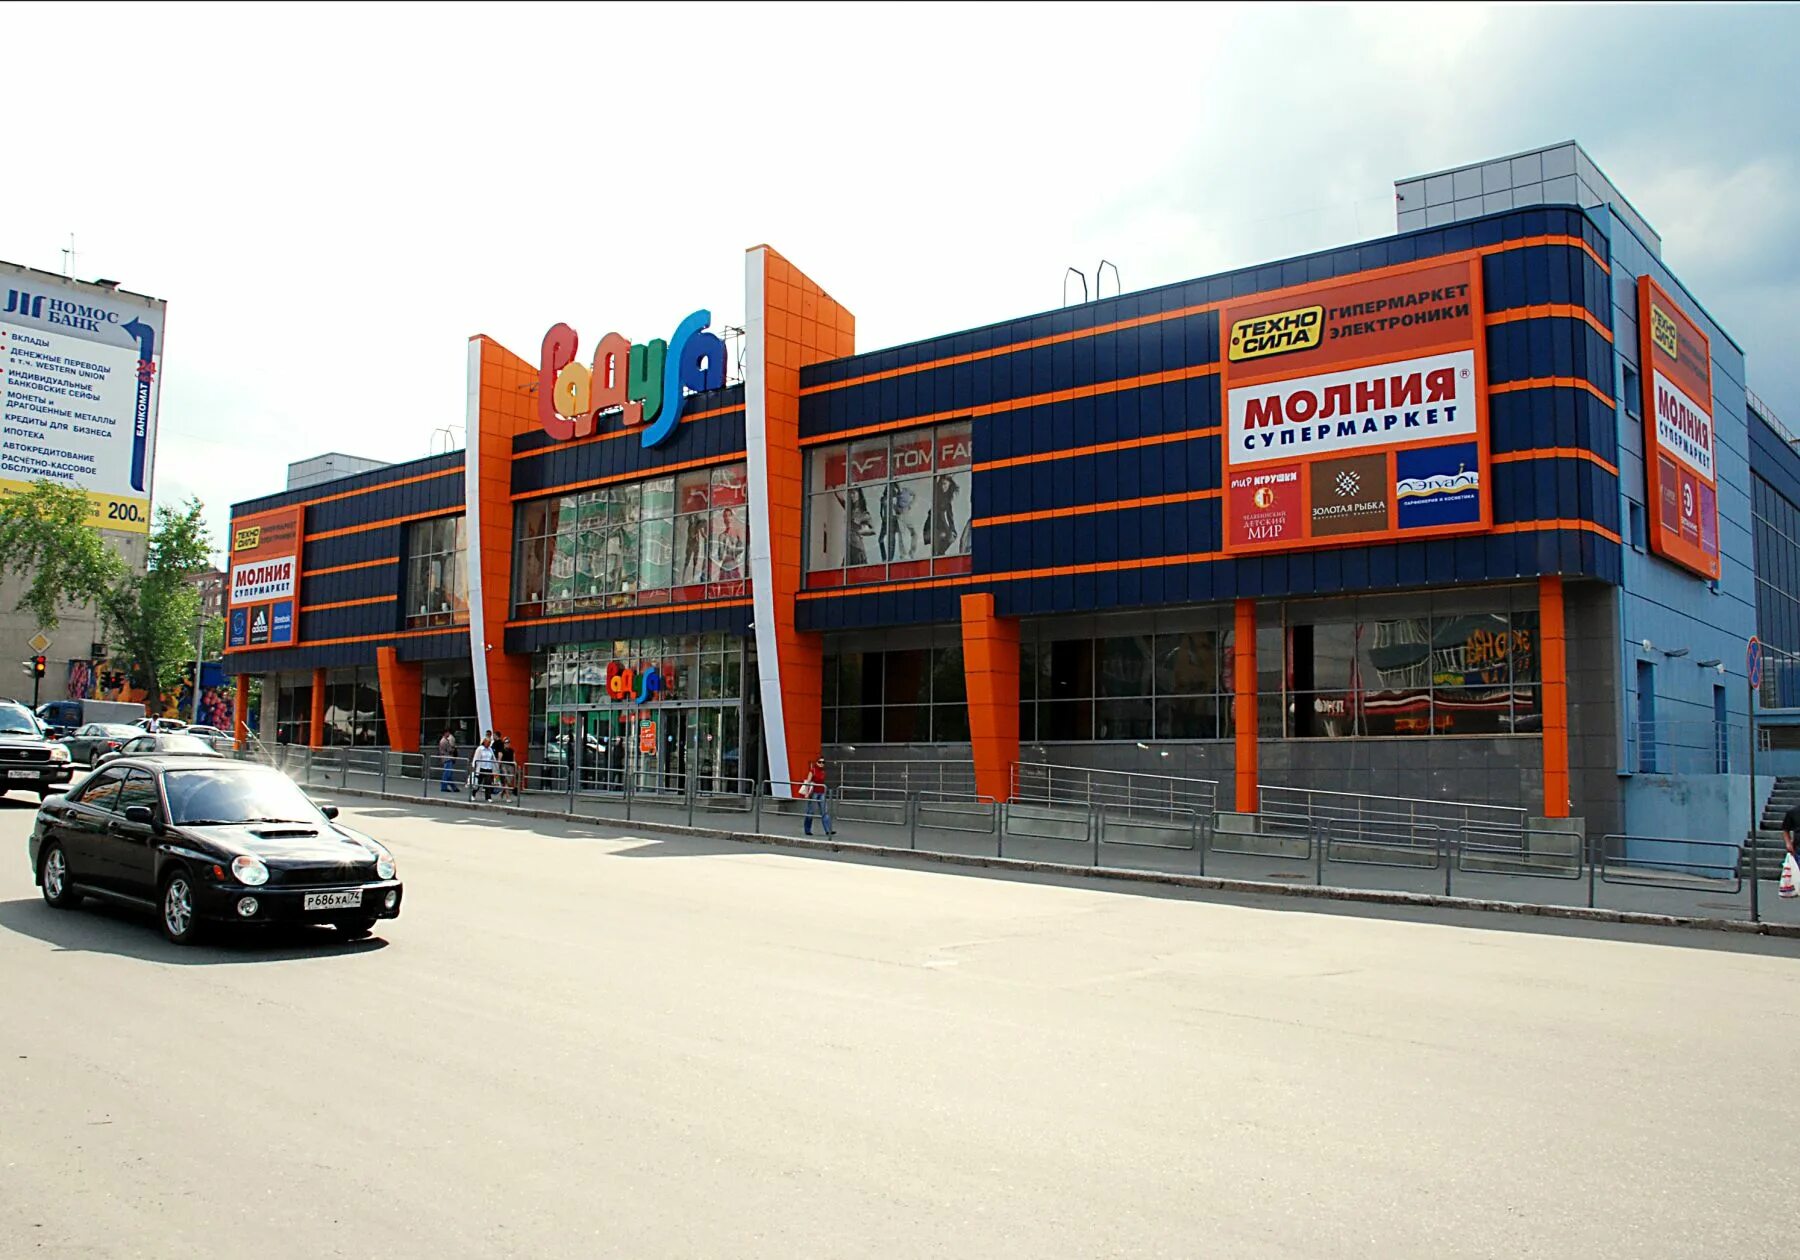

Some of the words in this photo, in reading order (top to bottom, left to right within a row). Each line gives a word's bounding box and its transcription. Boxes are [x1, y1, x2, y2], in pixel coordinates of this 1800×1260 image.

[49, 298, 119, 324] НОМОС
[1329, 283, 1469, 321] ГИПЕРМАРКЕТ
[48, 310, 100, 333] БАНК
[1238, 311, 1318, 339] ТЕХНО
[1329, 303, 1470, 339] ЭЛЕКТРОНИКИ
[11, 333, 50, 348] ВКЛАДЫ
[1243, 330, 1310, 354] СИЛА
[10, 347, 62, 364] ДЕНЕЖНЫЕ
[64, 358, 111, 374] ПЕРЕВОДЫ
[36, 361, 77, 375] WESTERN
[78, 369, 106, 381] UNION
[8, 369, 93, 391] ИНДИВИДУАЛЬНЫЕ
[8, 378, 66, 395] БАНКОВСКИЕ
[68, 388, 101, 402] СЕЙФЫ
[7, 391, 47, 404] МОНЕТЫ
[1243, 367, 1456, 430] МОЛНИЯ
[6, 399, 72, 418] ДРАГОЦЕННЫЕ
[74, 411, 117, 425] МЕТАЛЛЫ
[136, 383, 148, 437] БАНКОМАТ
[1658, 385, 1709, 451] МОЛНИЯ
[4, 413, 48, 427] КРЕДИТЫ
[50, 421, 69, 430] ДЛЯ
[73, 425, 112, 438] БИЗНЕСА
[4, 427, 45, 440] ИПОТЕКА
[1244, 405, 1457, 450] СУПЕРМАРКЕТ
[2, 441, 95, 463] АВТОКРЕДИТОВАНИЕ
[1659, 420, 1710, 470] СУПЕРМАРКЕТ
[894, 449, 932, 468] TOM
[1, 463, 75, 480] ОБСЛУЖИВАНИЕ
[1254, 472, 1297, 486] ИГРУШКИ
[1312, 504, 1353, 516] ЗОЛОТАЯ
[1354, 500, 1386, 512] РЫБКА
[1444, 494, 1475, 502] КОСМЕТИКА
[238, 528, 260, 540] ТЕХНО
[1243, 517, 1286, 529] ДЕТСКИЙ
[1247, 524, 1283, 540] МИР
[235, 562, 291, 588] МОЛНИЯ
[234, 582, 290, 598] СУПЕРМАРКЕТ
